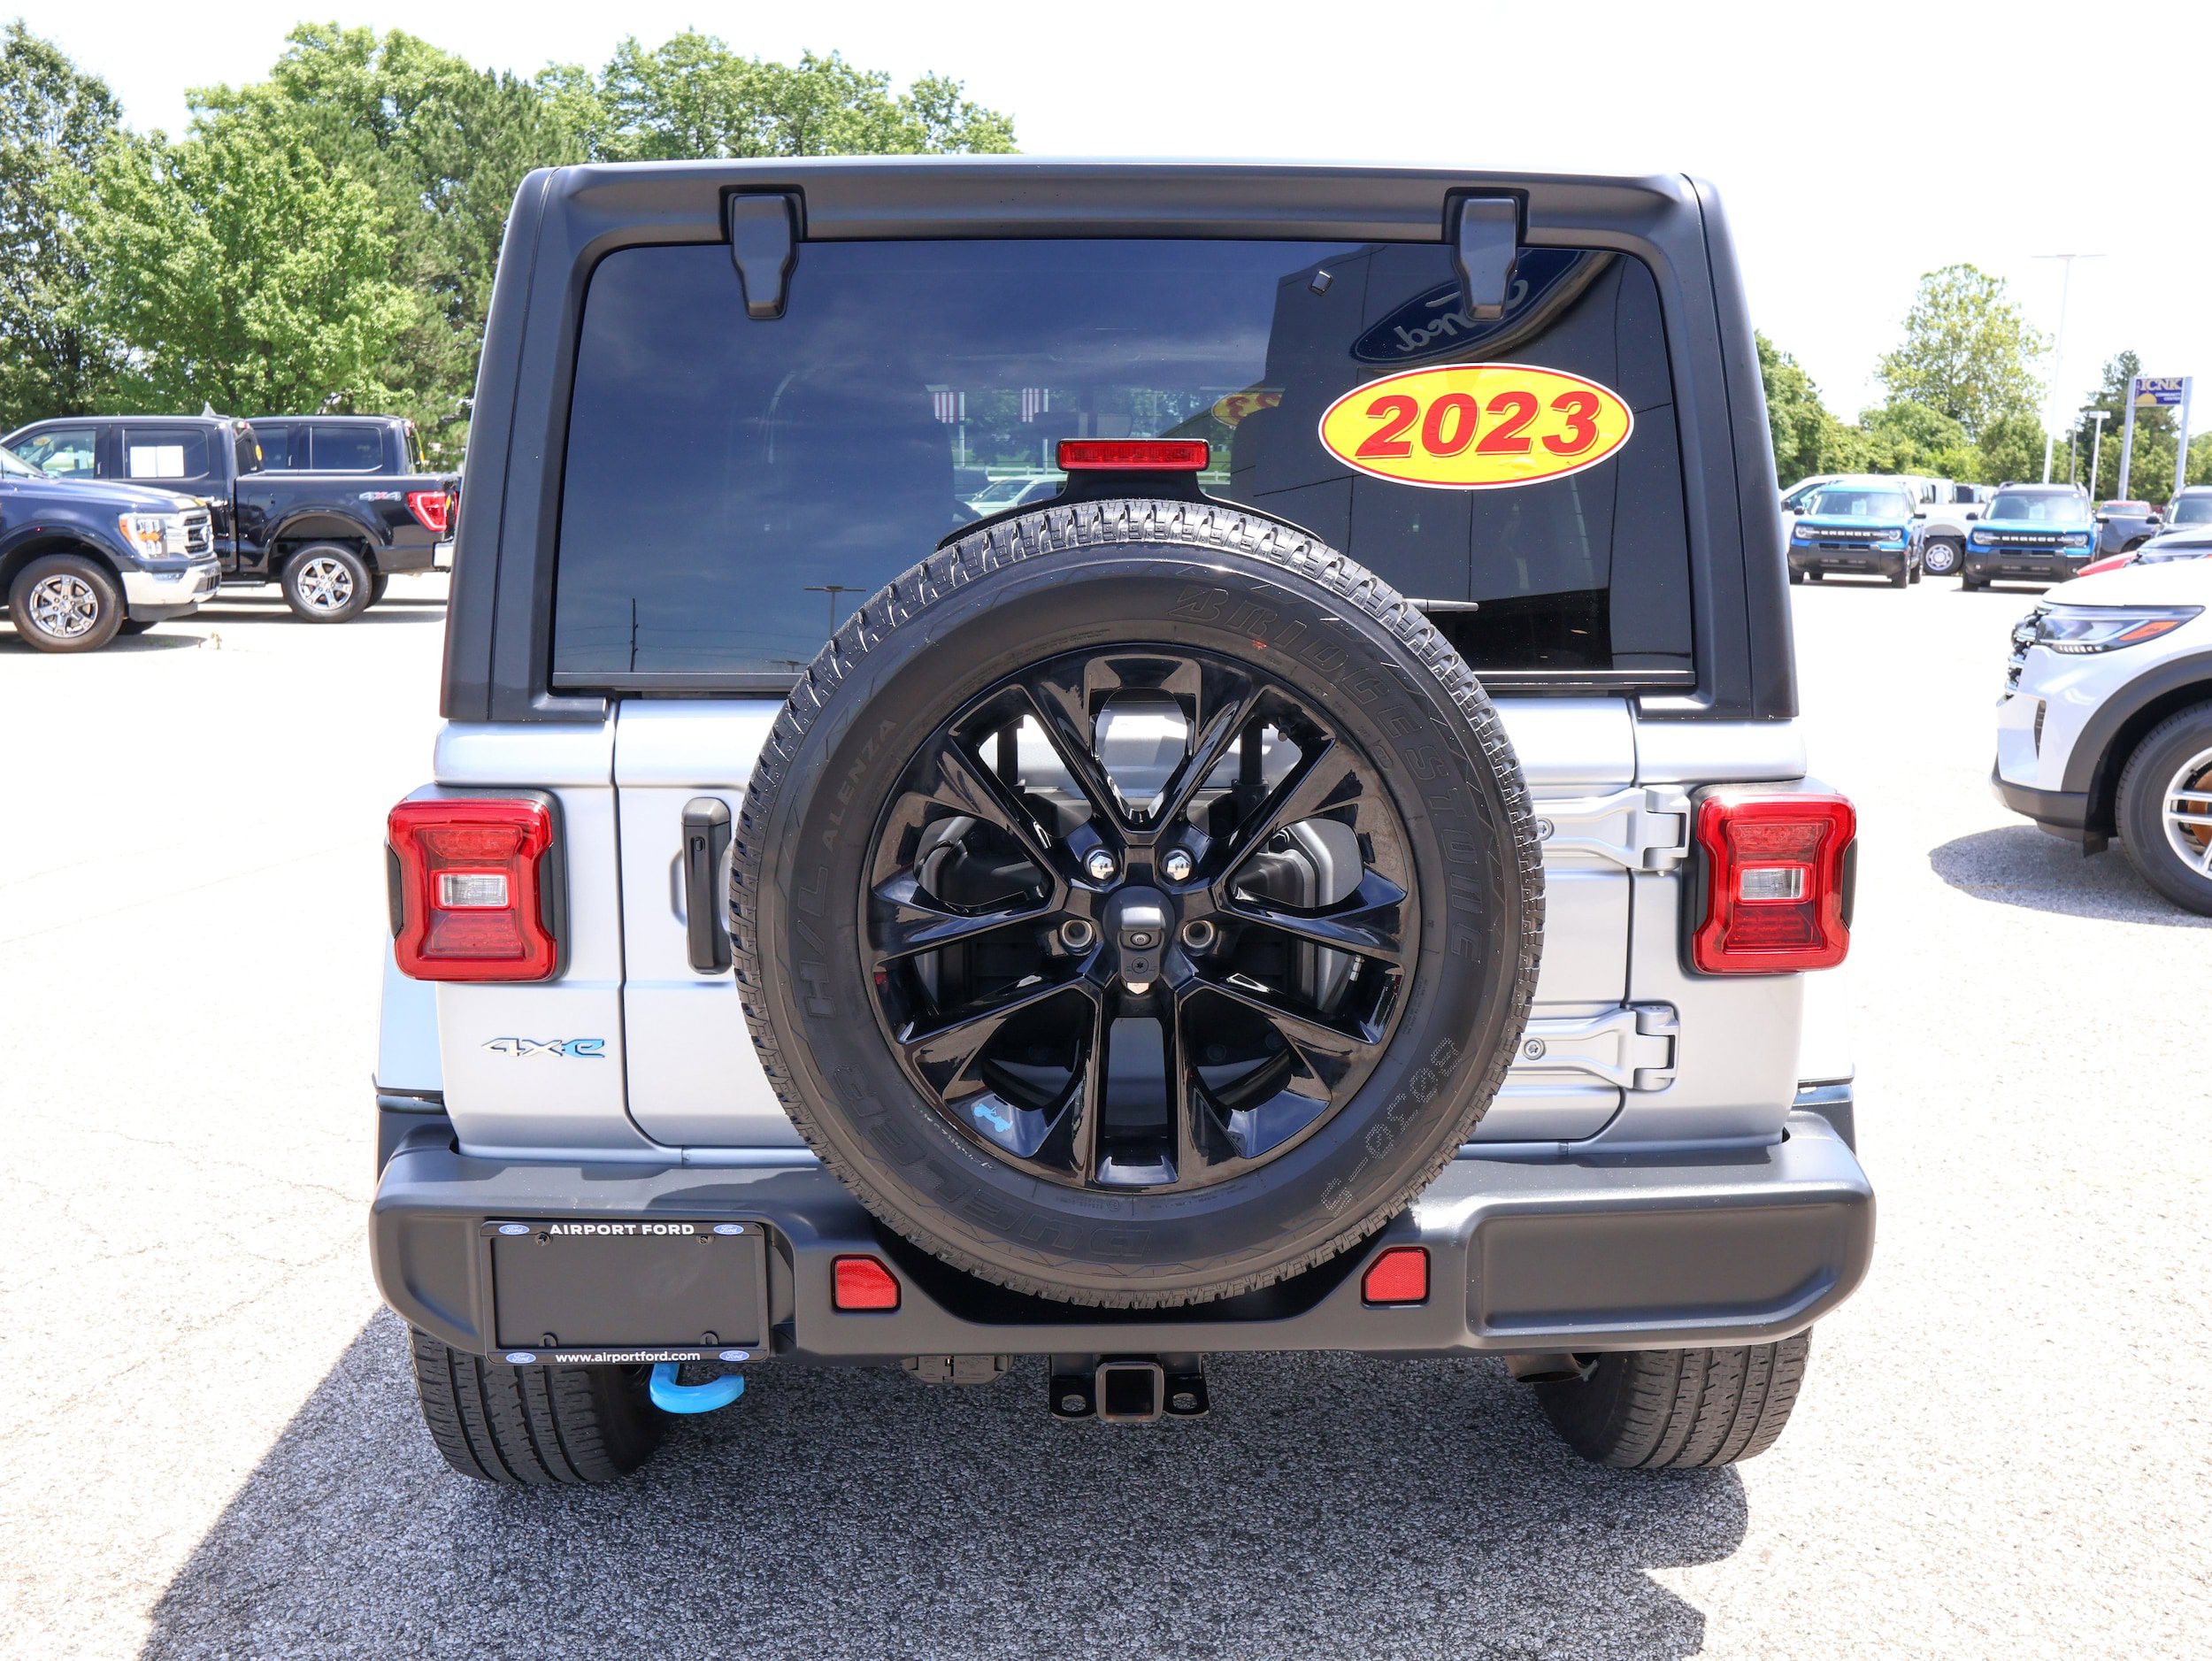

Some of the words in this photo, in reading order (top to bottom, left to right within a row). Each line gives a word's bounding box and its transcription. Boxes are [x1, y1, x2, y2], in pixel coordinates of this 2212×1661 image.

[2140, 378, 2182, 391] ICNK
[1355, 390, 1602, 459] 2023
[821, 718, 897, 854] ALENZA
[1167, 583, 1486, 965] BRIDGESTONE
[833, 1062, 1151, 1257] DUELER
[549, 1224, 636, 1235] AIRPORT
[641, 1224, 695, 1235] FORD
[555, 1351, 701, 1364] www.airportford.com
